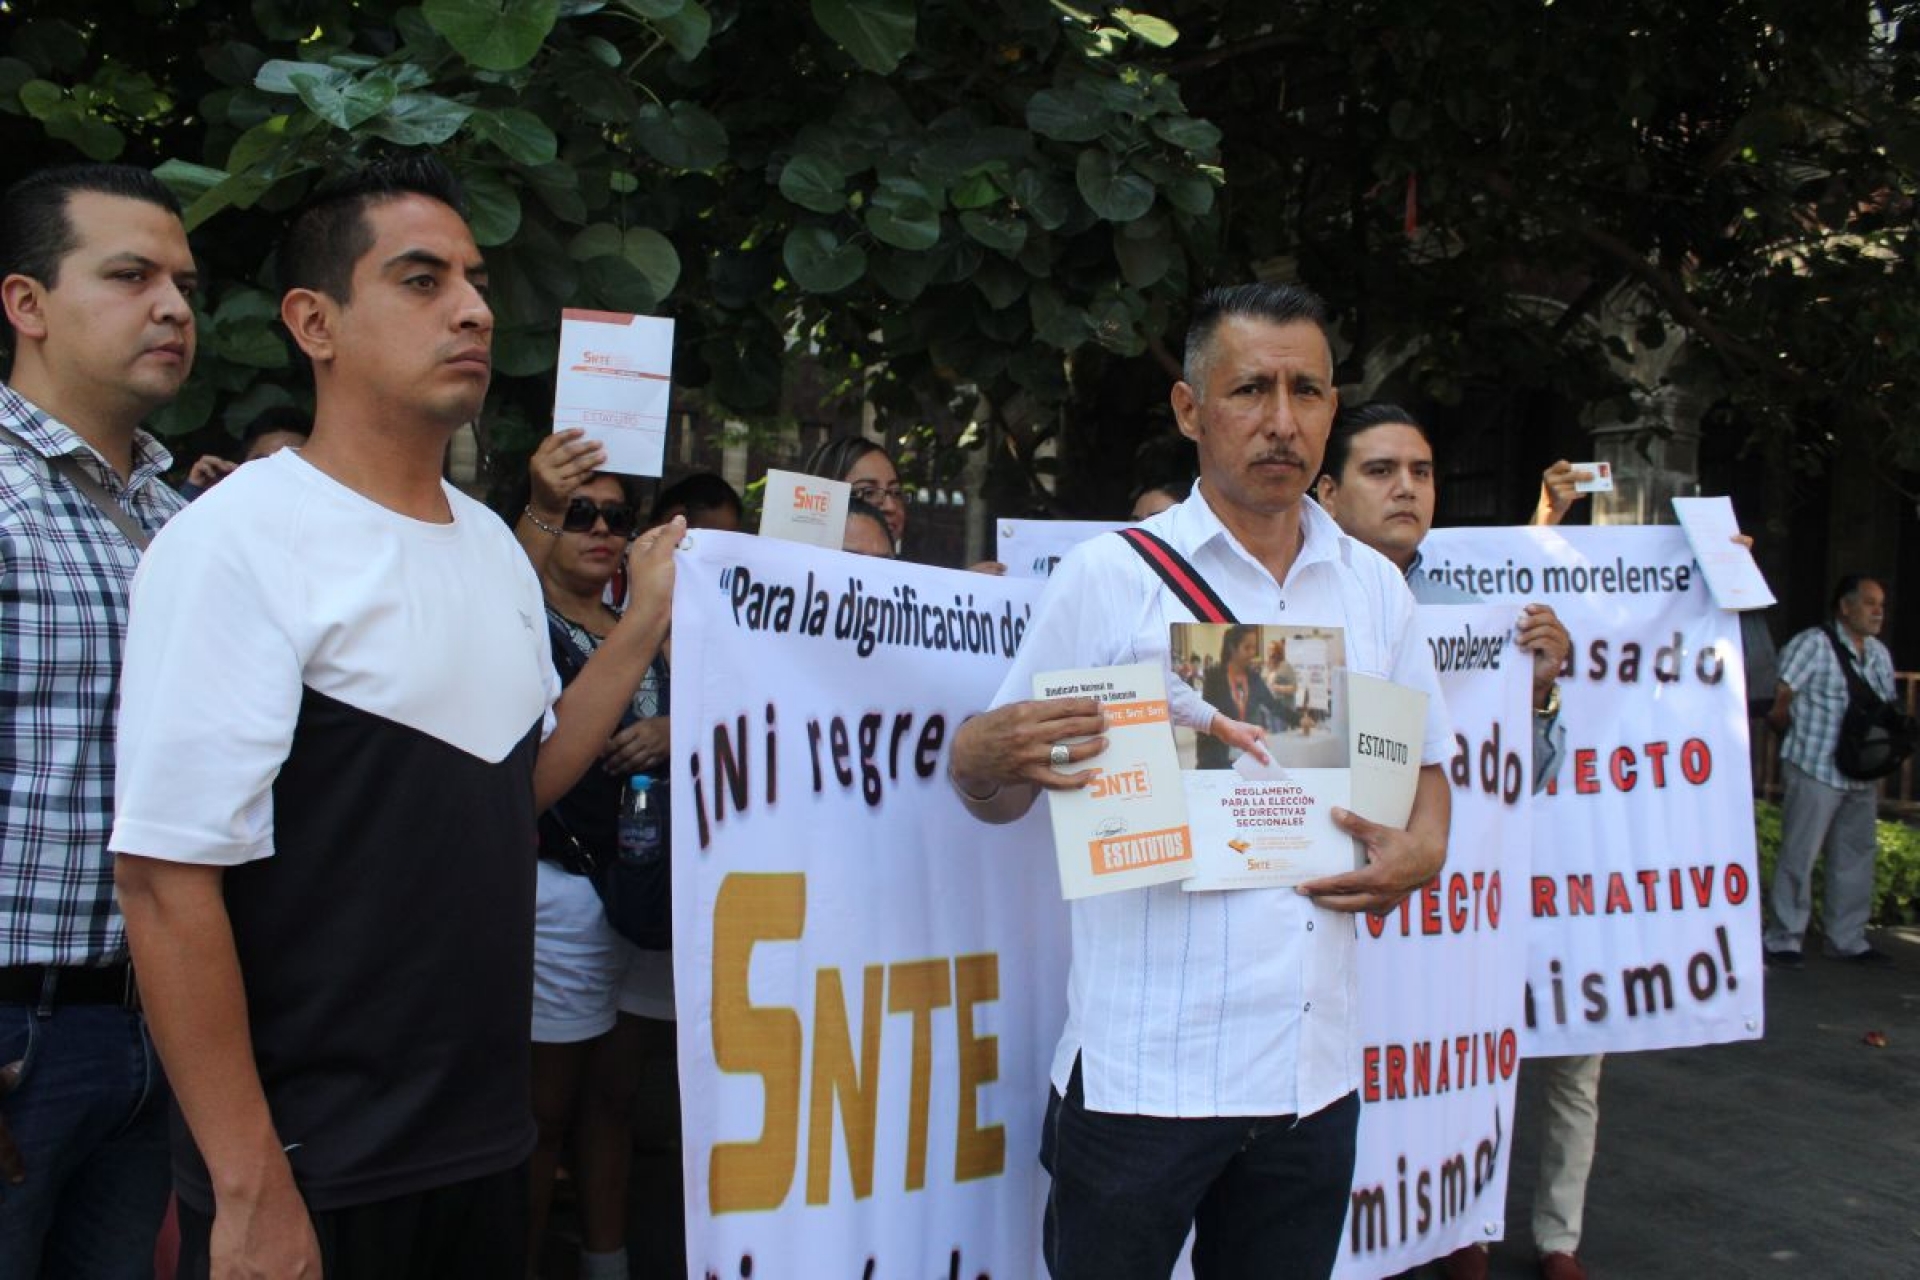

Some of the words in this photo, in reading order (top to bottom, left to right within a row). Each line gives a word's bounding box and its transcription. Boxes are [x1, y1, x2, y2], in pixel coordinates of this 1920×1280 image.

[793, 485, 827, 512] SNTE
[800, 571, 829, 637] la
[834, 577, 996, 657] dignificación
[806, 712, 975, 806] regre
[1358, 732, 1409, 765] ESTATUTO
[1547, 737, 1712, 795] ECTO
[1221, 798, 1249, 806] PARA
[1252, 797, 1266, 806] LA
[1268, 795, 1315, 806] ELECCIÓN
[1234, 786, 1303, 796] REGLAMENTO
[1233, 808, 1246, 817] DE
[1249, 807, 1306, 817] DIRECTIVAS
[1236, 818, 1305, 828] SECCIONALES
[1103, 832, 1184, 870] ESTATUTOS
[1531, 863, 1749, 917] RNATIVO
[709, 872, 1005, 1216] SNTE
[1363, 1028, 1518, 1103] ERNATIVO
